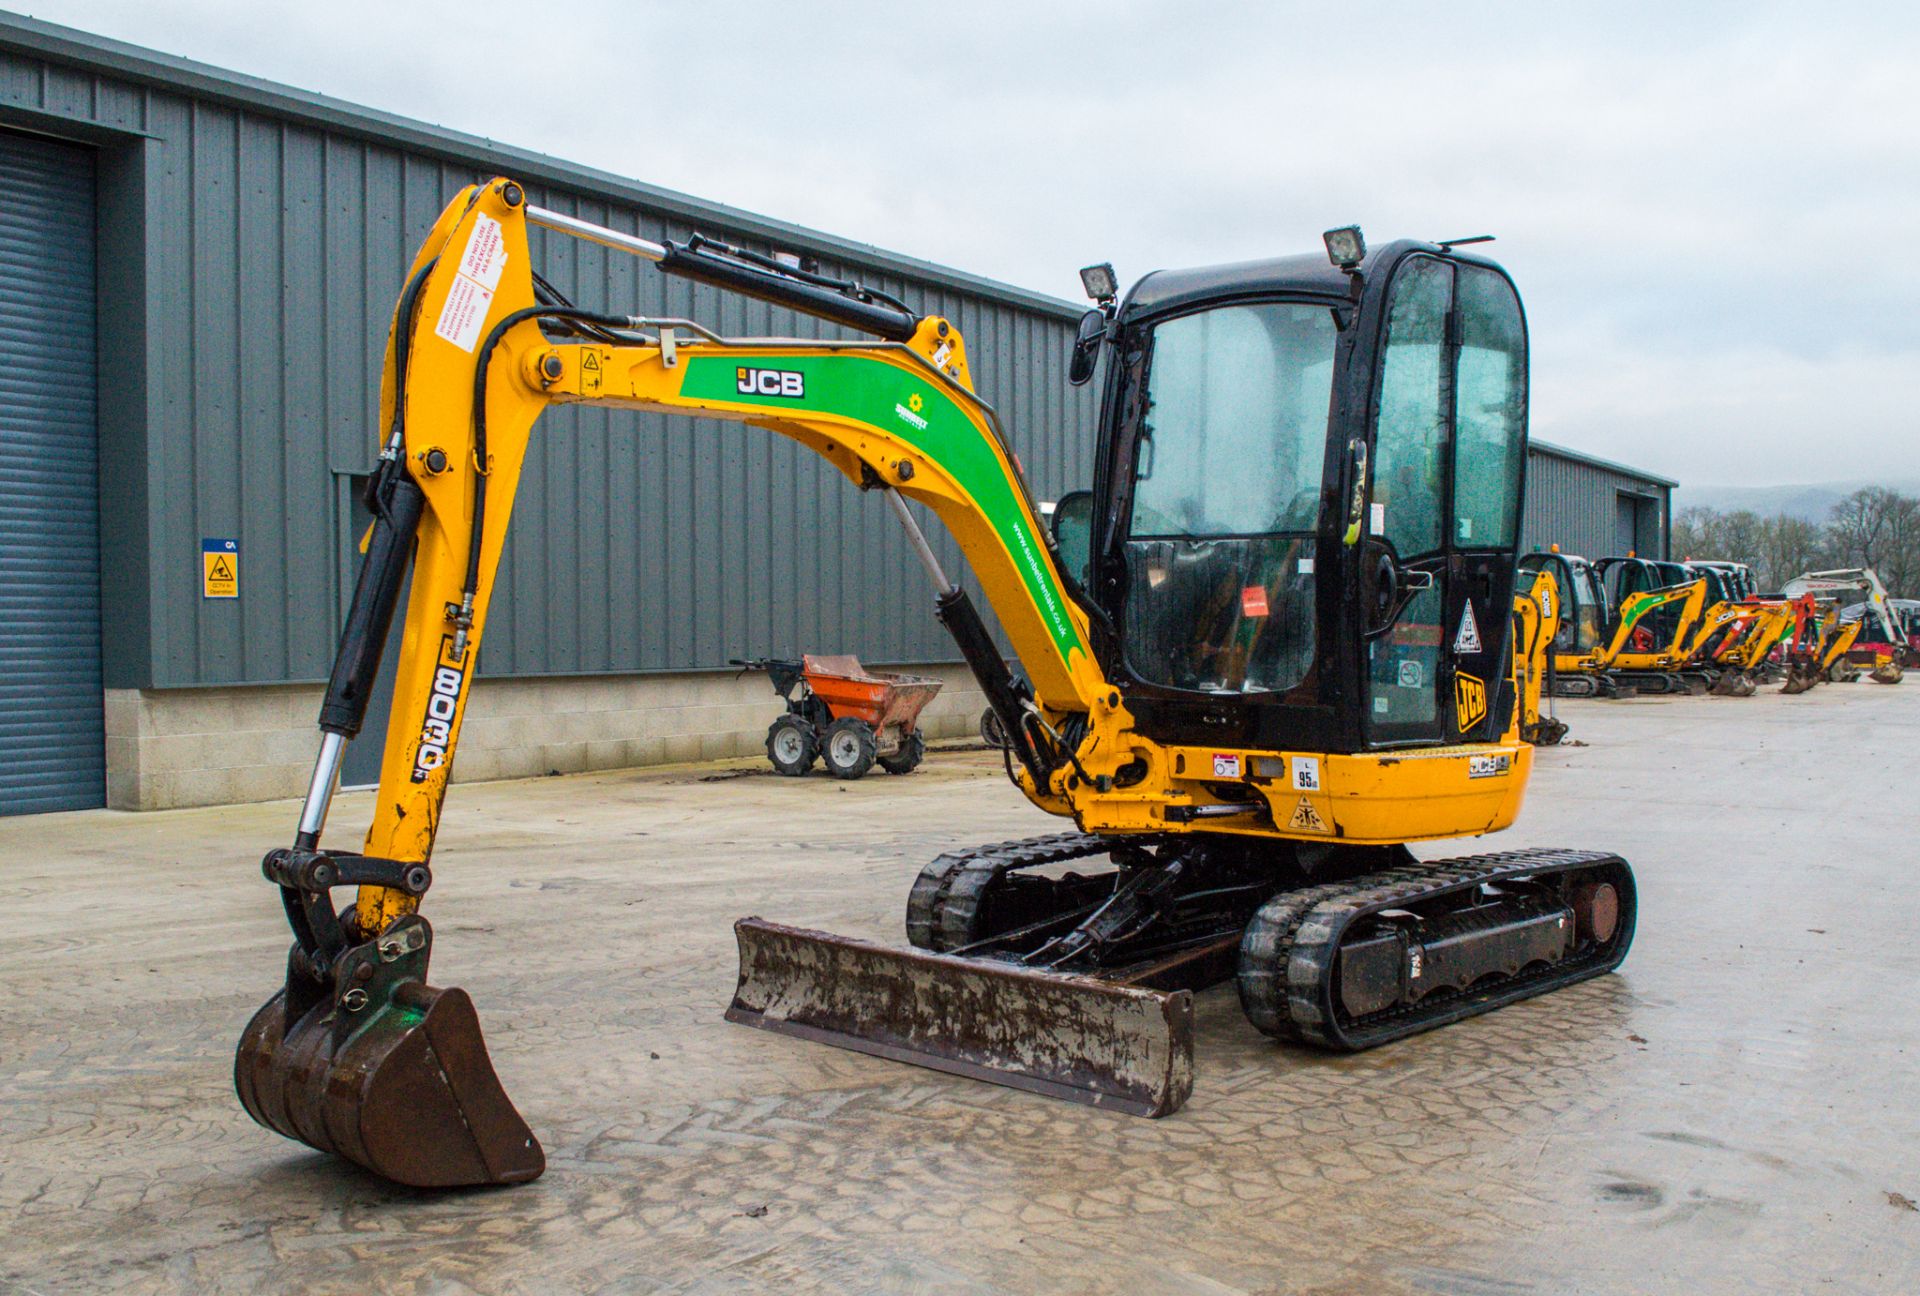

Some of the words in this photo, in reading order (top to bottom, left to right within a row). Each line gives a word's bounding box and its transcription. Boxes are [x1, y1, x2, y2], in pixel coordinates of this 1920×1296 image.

[467, 256, 475, 267] DO
[472, 239, 481, 255] NOT
[478, 224, 486, 239] USE
[471, 262, 481, 278] THIS
[477, 222, 496, 262] EXCAVATOR
[481, 264, 488, 274] AS
[487, 235, 498, 258] CRANE
[738, 369, 803, 396] JCB
[1013, 522, 1066, 637] www.sunbeltrentals.co.uk
[417, 667, 461, 770] 8030
[1459, 678, 1484, 726] JCB
[1299, 771, 1312, 787] 95
